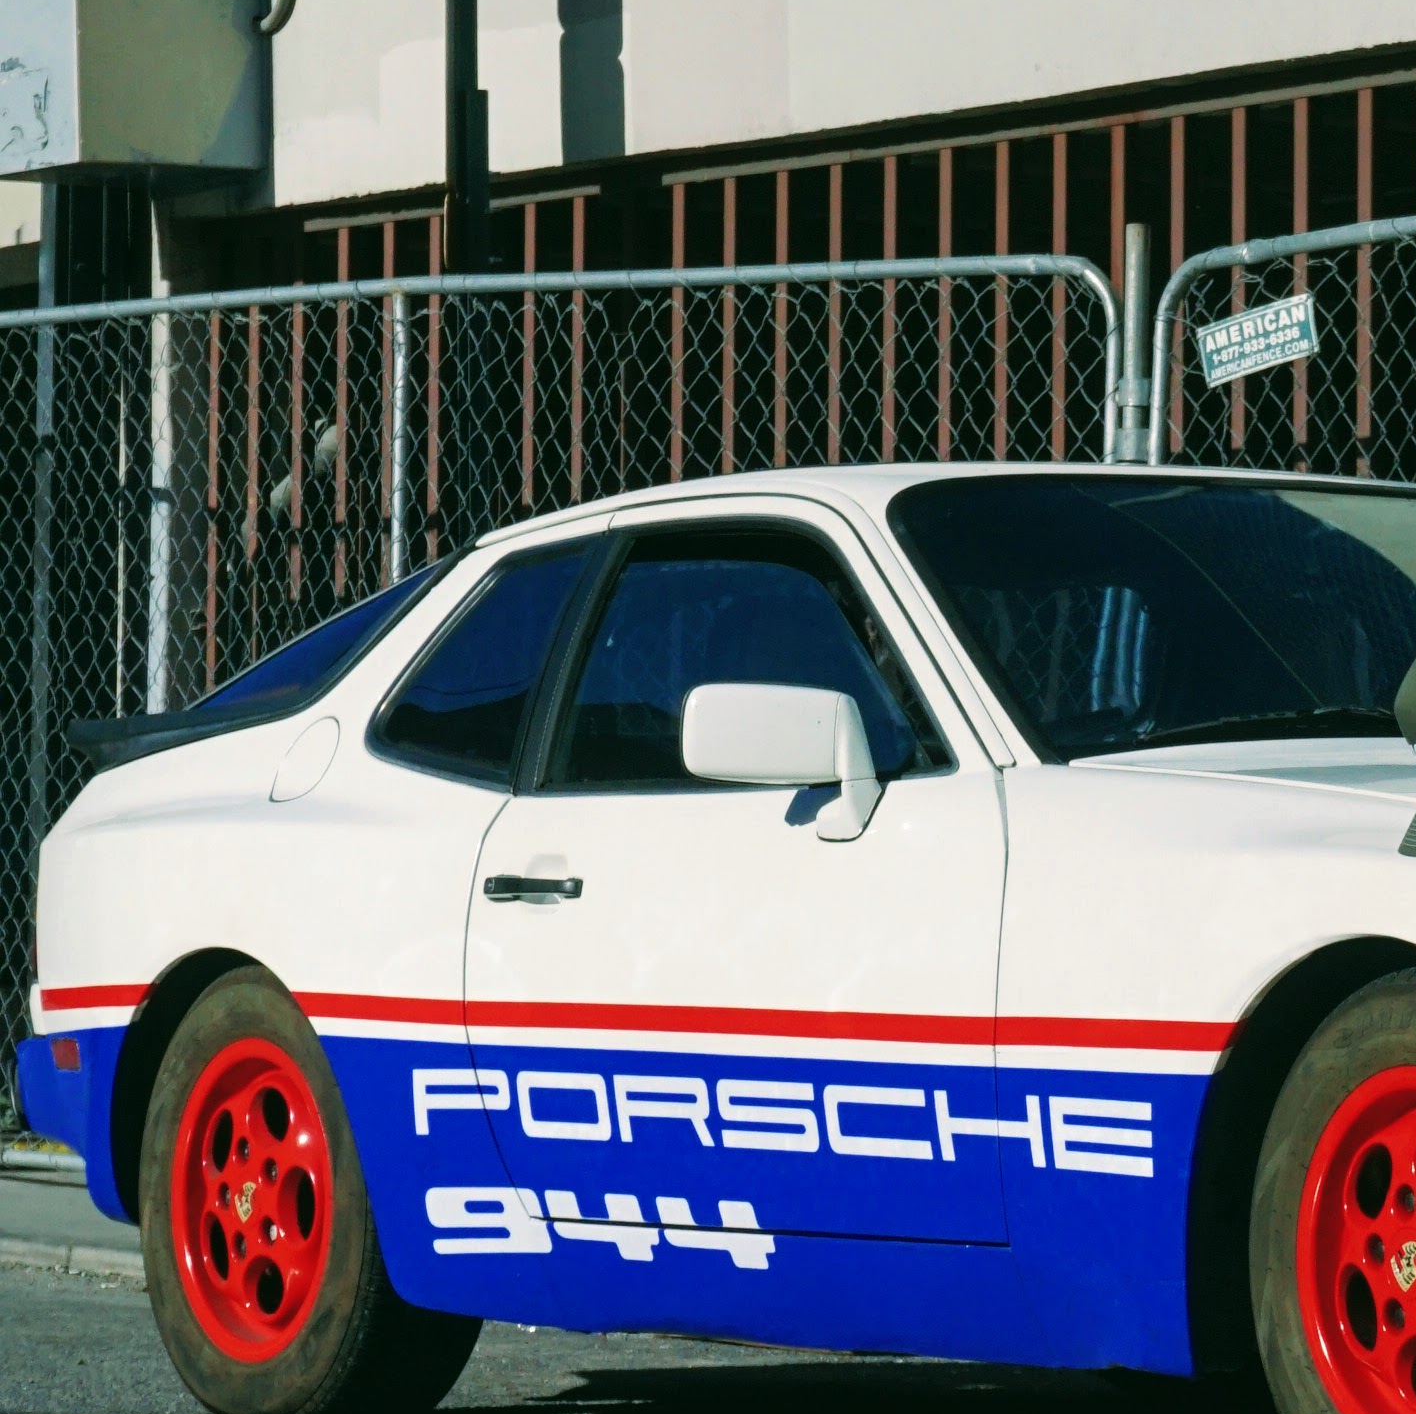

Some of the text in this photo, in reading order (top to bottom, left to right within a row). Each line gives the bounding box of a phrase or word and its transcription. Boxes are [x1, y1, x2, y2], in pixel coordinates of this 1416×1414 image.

[1206, 304, 1306, 352] AMERICAN
[1212, 326, 1300, 365] 1-877-933-6336
[1211, 339, 1309, 380] AMERICANFENCE.COM
[412, 1068, 1154, 1178] PORSCHE
[425, 1187, 776, 1270] 944
